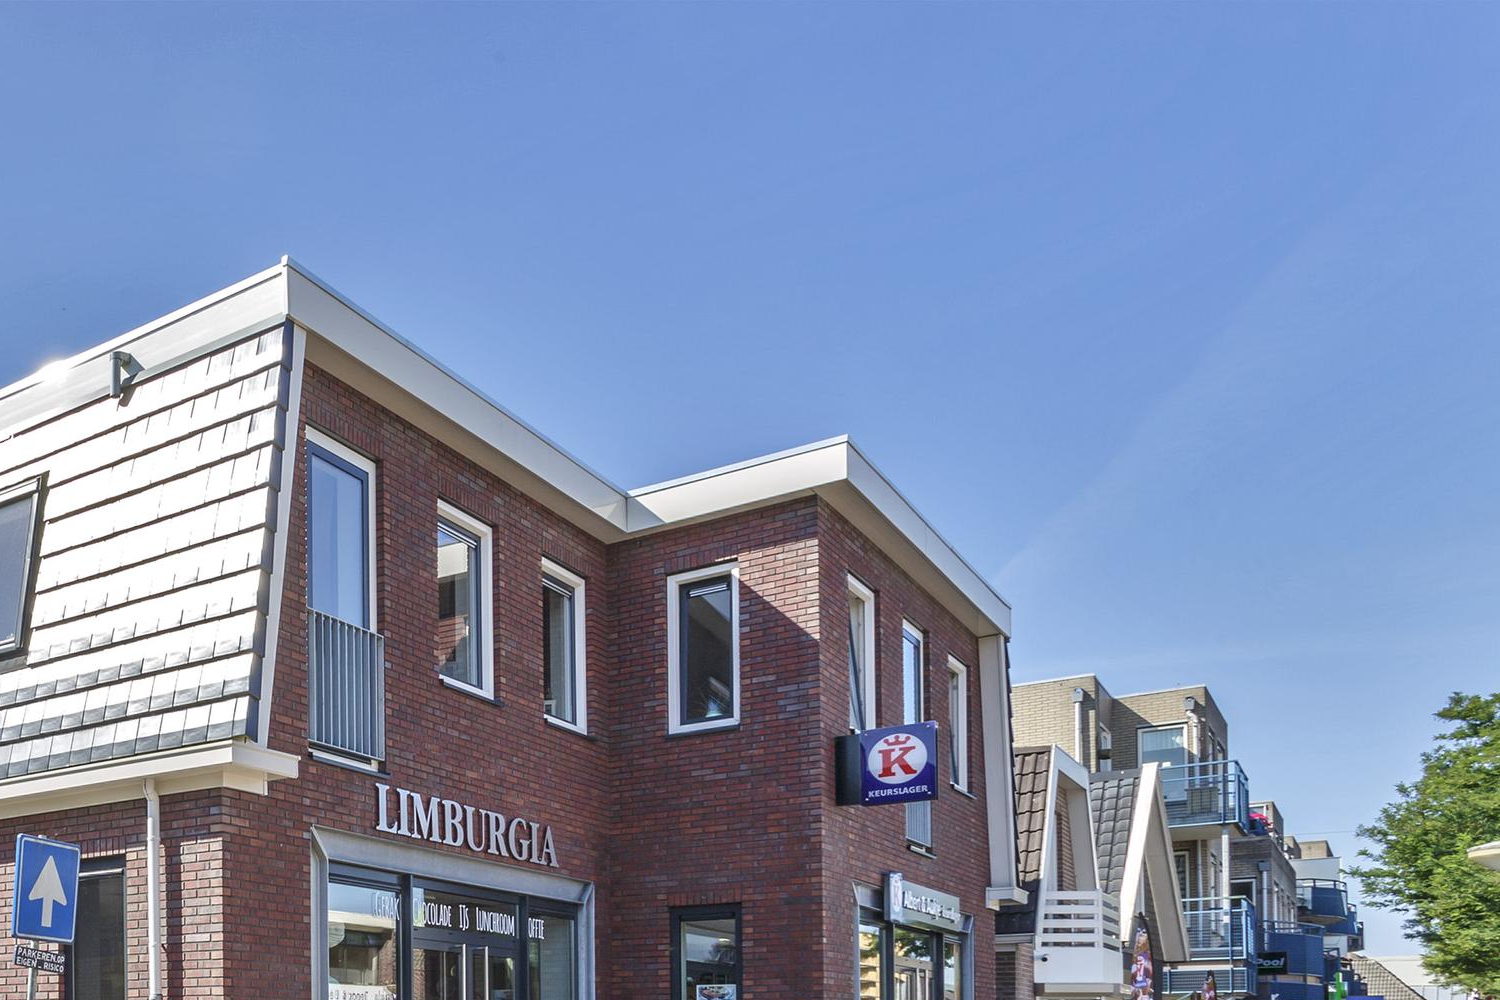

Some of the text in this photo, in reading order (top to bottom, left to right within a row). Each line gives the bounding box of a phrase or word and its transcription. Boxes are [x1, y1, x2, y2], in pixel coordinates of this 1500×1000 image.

[878, 746, 917, 778] K
[868, 785, 928, 798] KEURSLAGER
[375, 783, 560, 868] LIMBURGIA
[528, 917, 545, 939] OFFIE
[16, 956, 37, 968] EIGEN
[43, 961, 65, 973] RISICO
